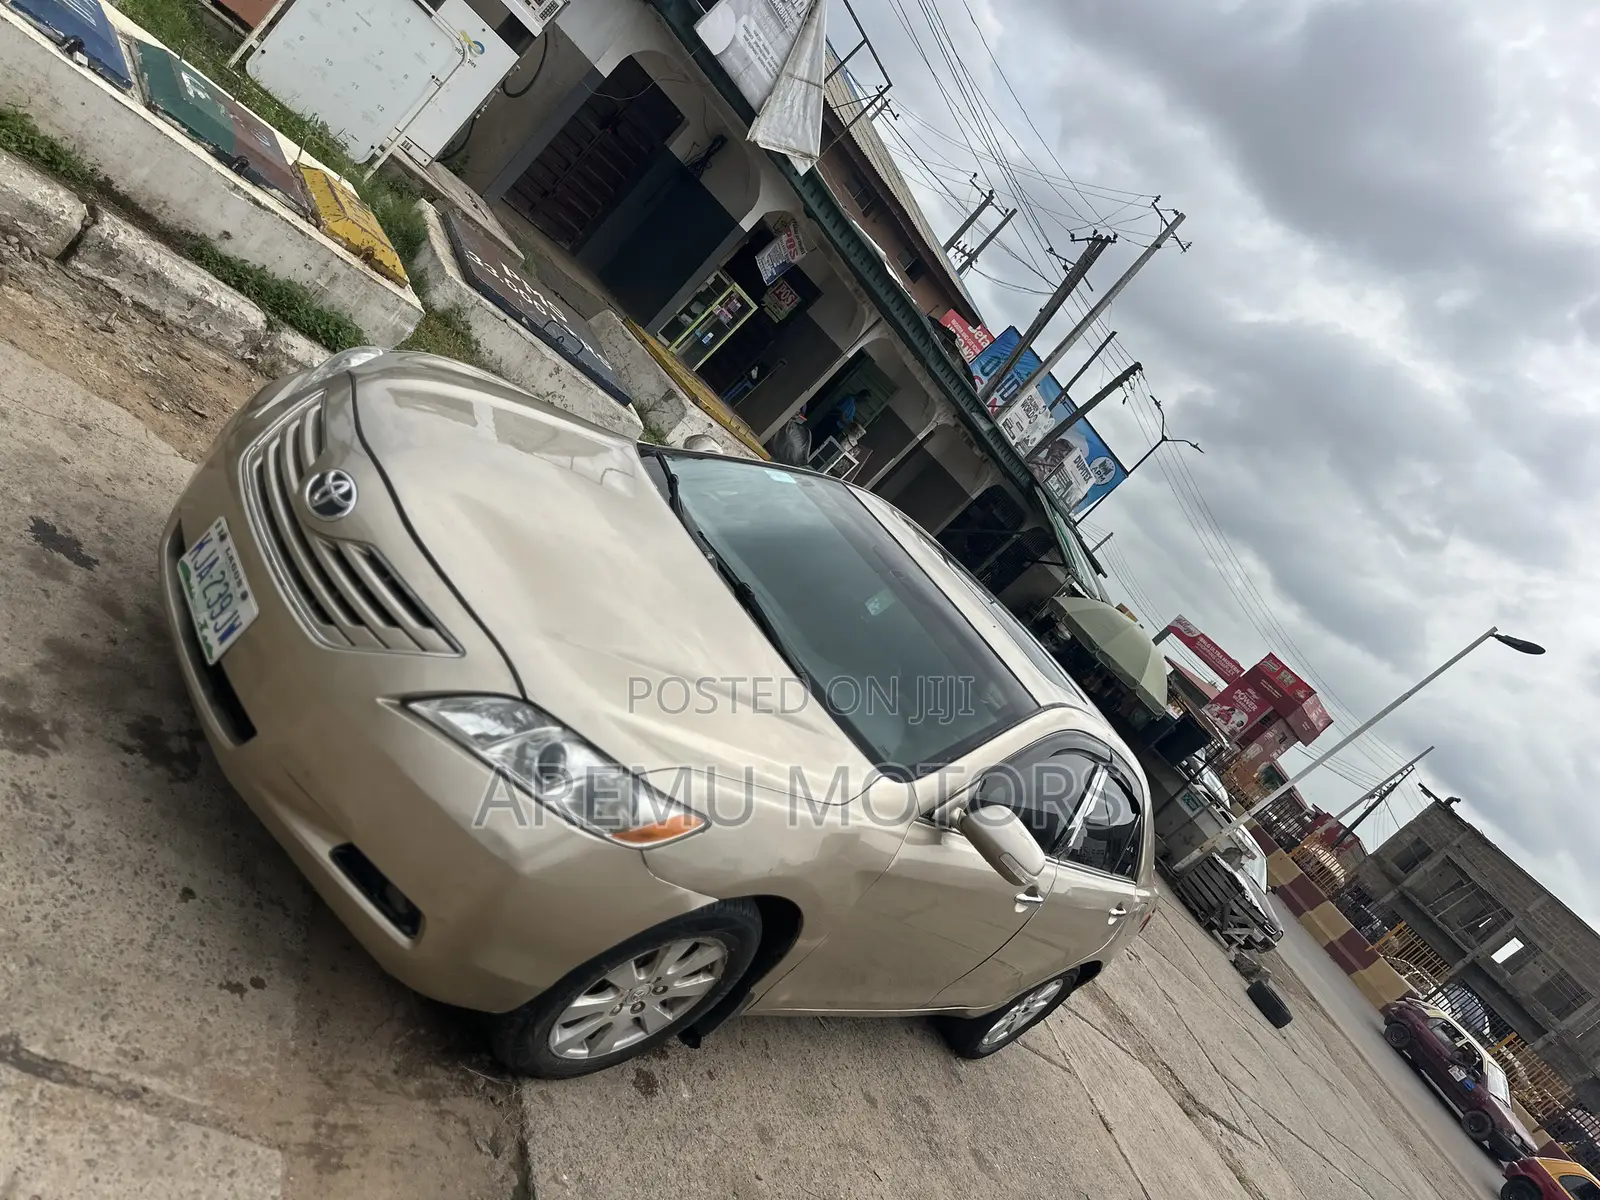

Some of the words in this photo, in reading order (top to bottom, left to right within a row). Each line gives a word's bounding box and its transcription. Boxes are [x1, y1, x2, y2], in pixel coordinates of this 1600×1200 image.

[784, 227, 799, 260] POS
[501, 261, 568, 323] PMS
[1073, 454, 1093, 484] DUPITEX
[1091, 466, 1107, 481] APM
[225, 546, 242, 588] LAGOS
[1234, 689, 1258, 712] POWER
